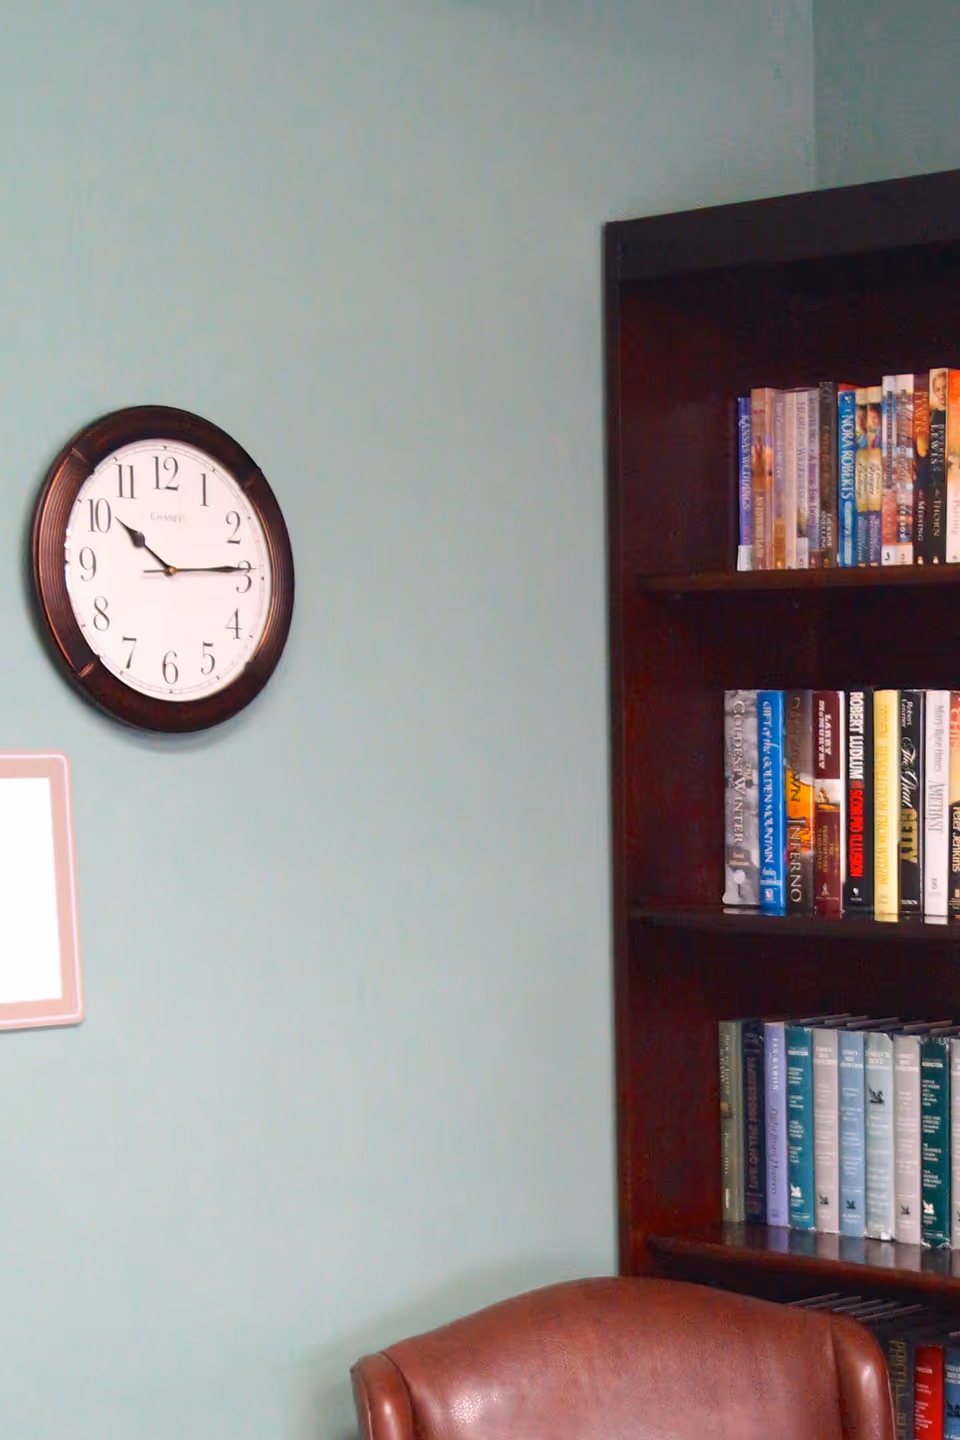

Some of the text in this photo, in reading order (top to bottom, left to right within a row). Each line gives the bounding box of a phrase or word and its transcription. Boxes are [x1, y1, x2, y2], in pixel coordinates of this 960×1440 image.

[152, 456, 179, 491] 12
[841, 415, 854, 499] NORA ROBERTS
[115, 464, 137, 499] 11
[199, 472, 210, 508] 1
[88, 498, 111, 533] 10
[226, 511, 241, 544] 2
[79, 547, 96, 581] 9
[236, 560, 252, 594] 3
[93, 596, 110, 631] 8
[225, 608, 242, 639] 4
[122, 636, 137, 669] 7
[162, 651, 179, 684] 6
[201, 642, 216, 675] 5
[849, 692, 864, 779] ROBERT LUDLUM
[732, 700, 745, 842] COLDEST WINTER
[785, 818, 805, 902] INFERNO
